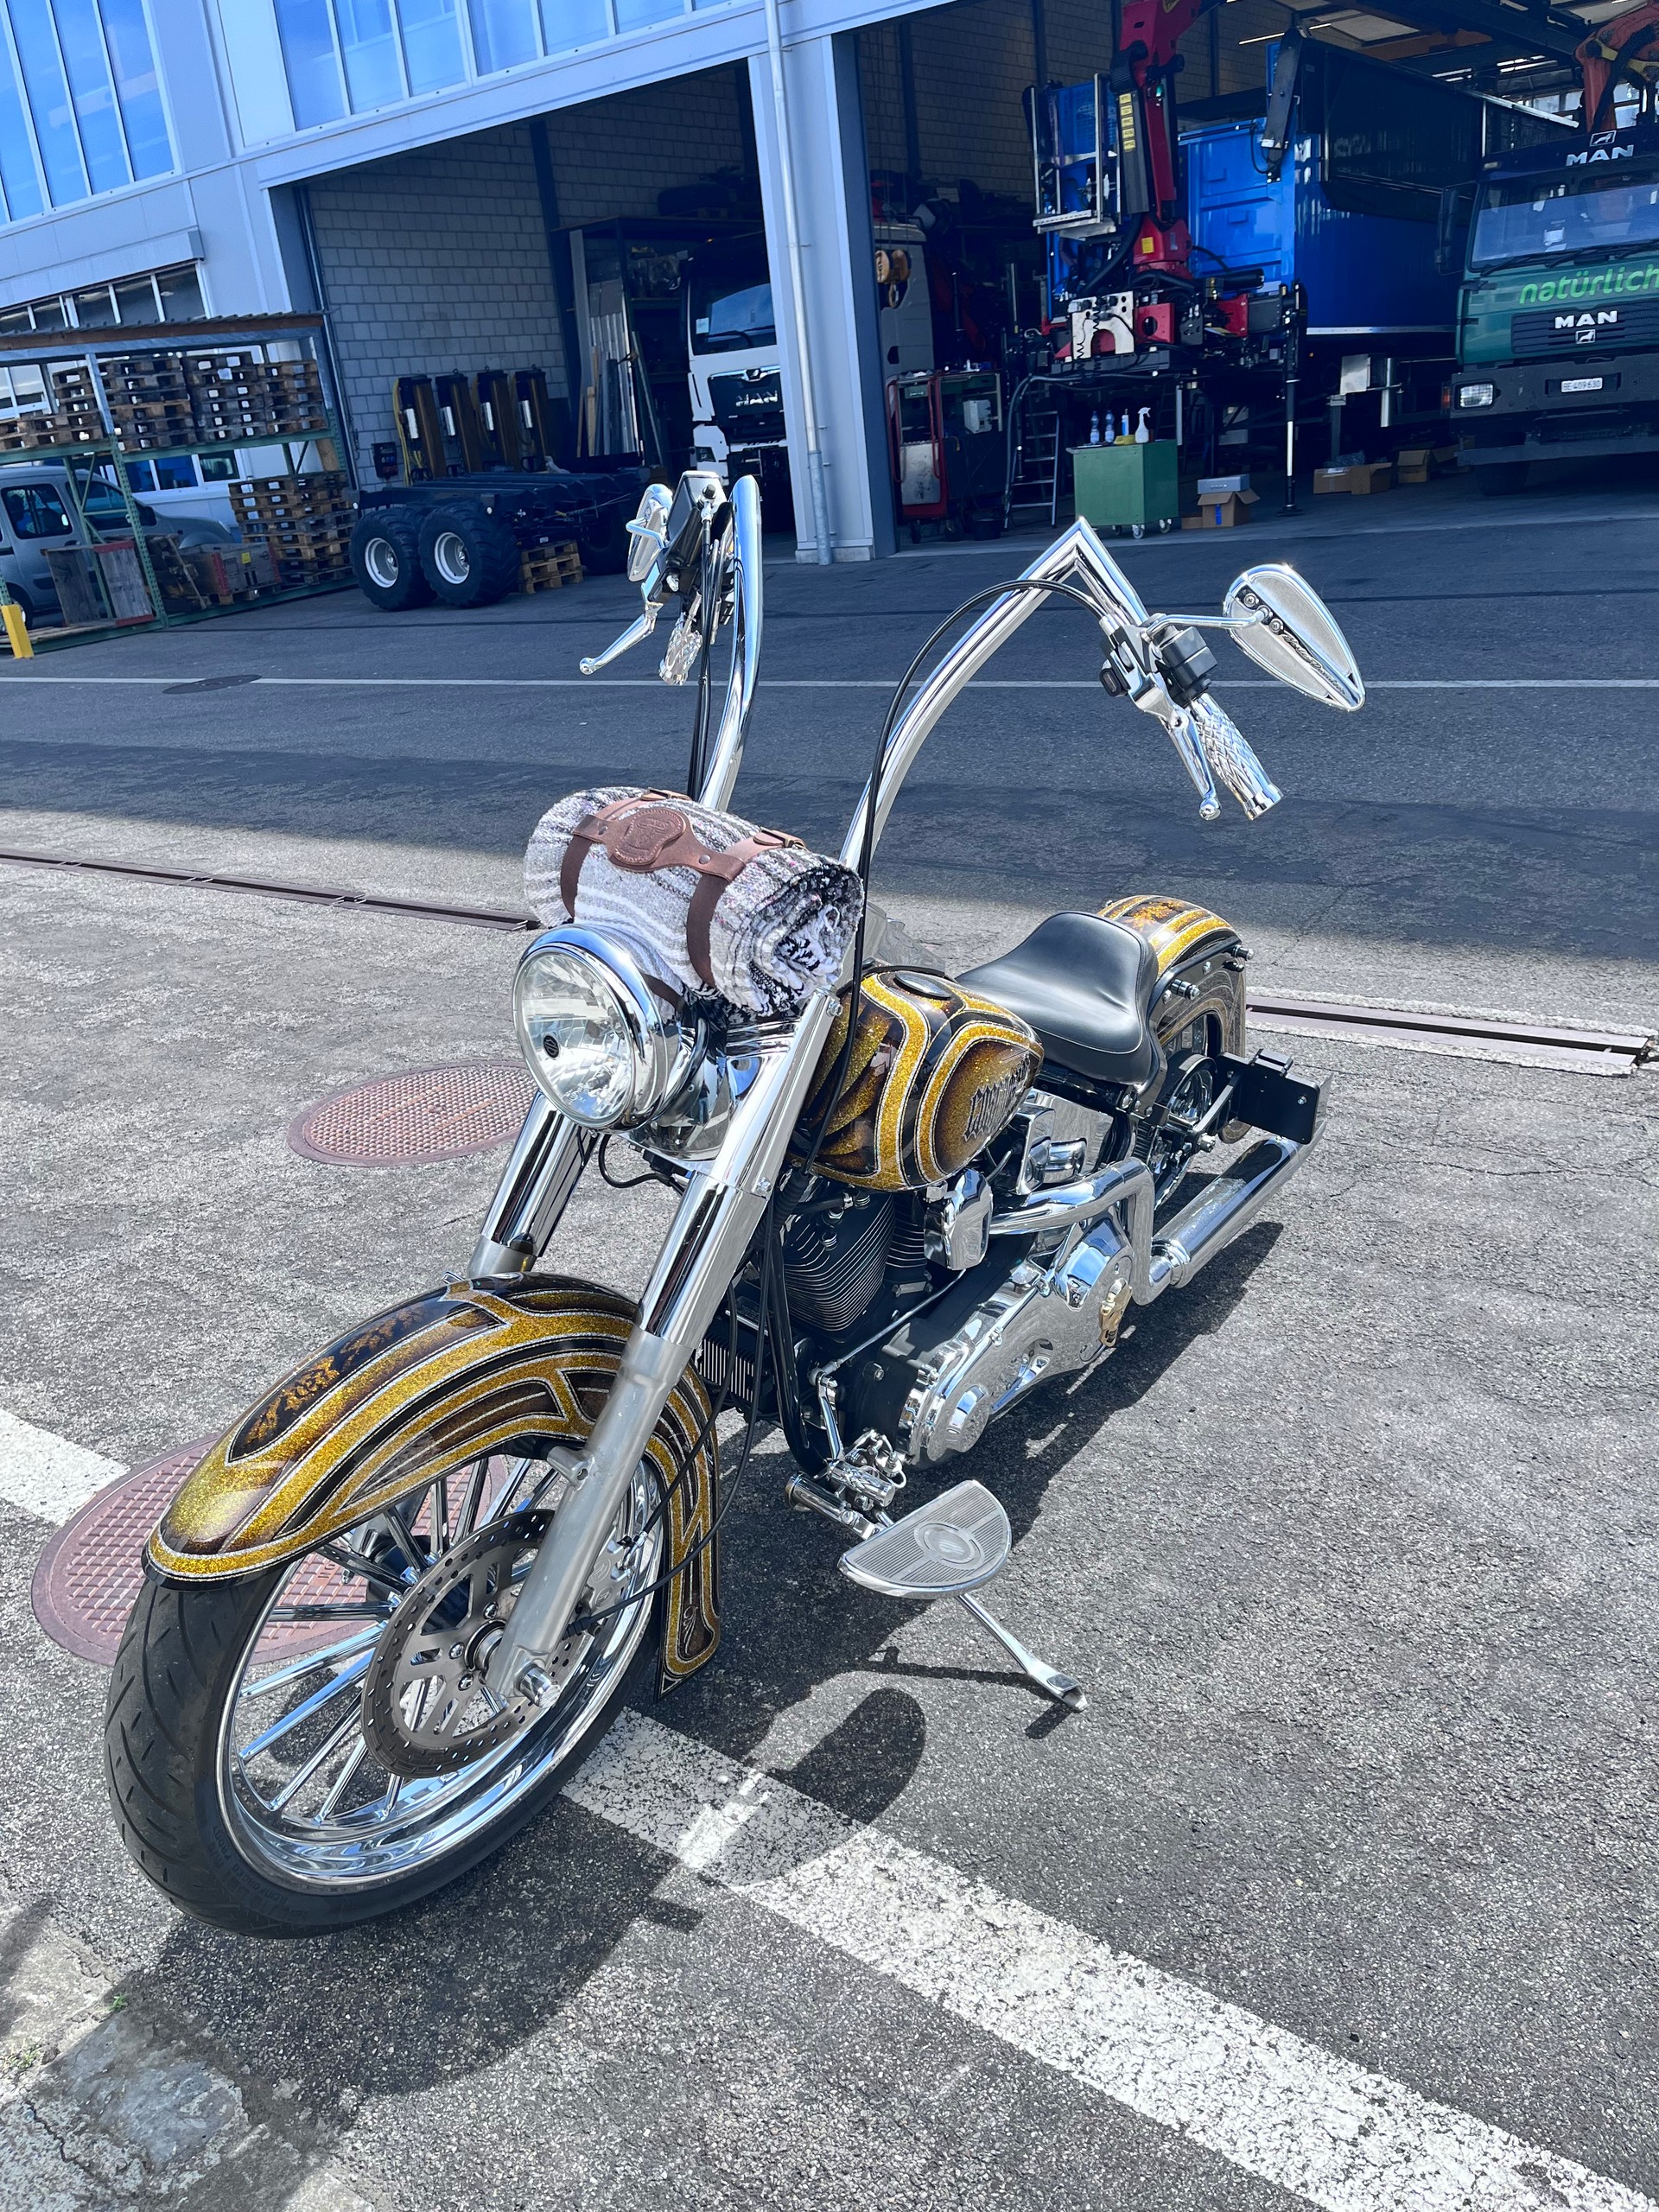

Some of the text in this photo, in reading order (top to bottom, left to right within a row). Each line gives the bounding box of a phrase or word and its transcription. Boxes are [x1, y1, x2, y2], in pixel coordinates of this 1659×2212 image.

[1566, 145, 1634, 167] MAN
[1519, 264, 1659, 304] natürlich
[1555, 310, 1618, 329] MAN
